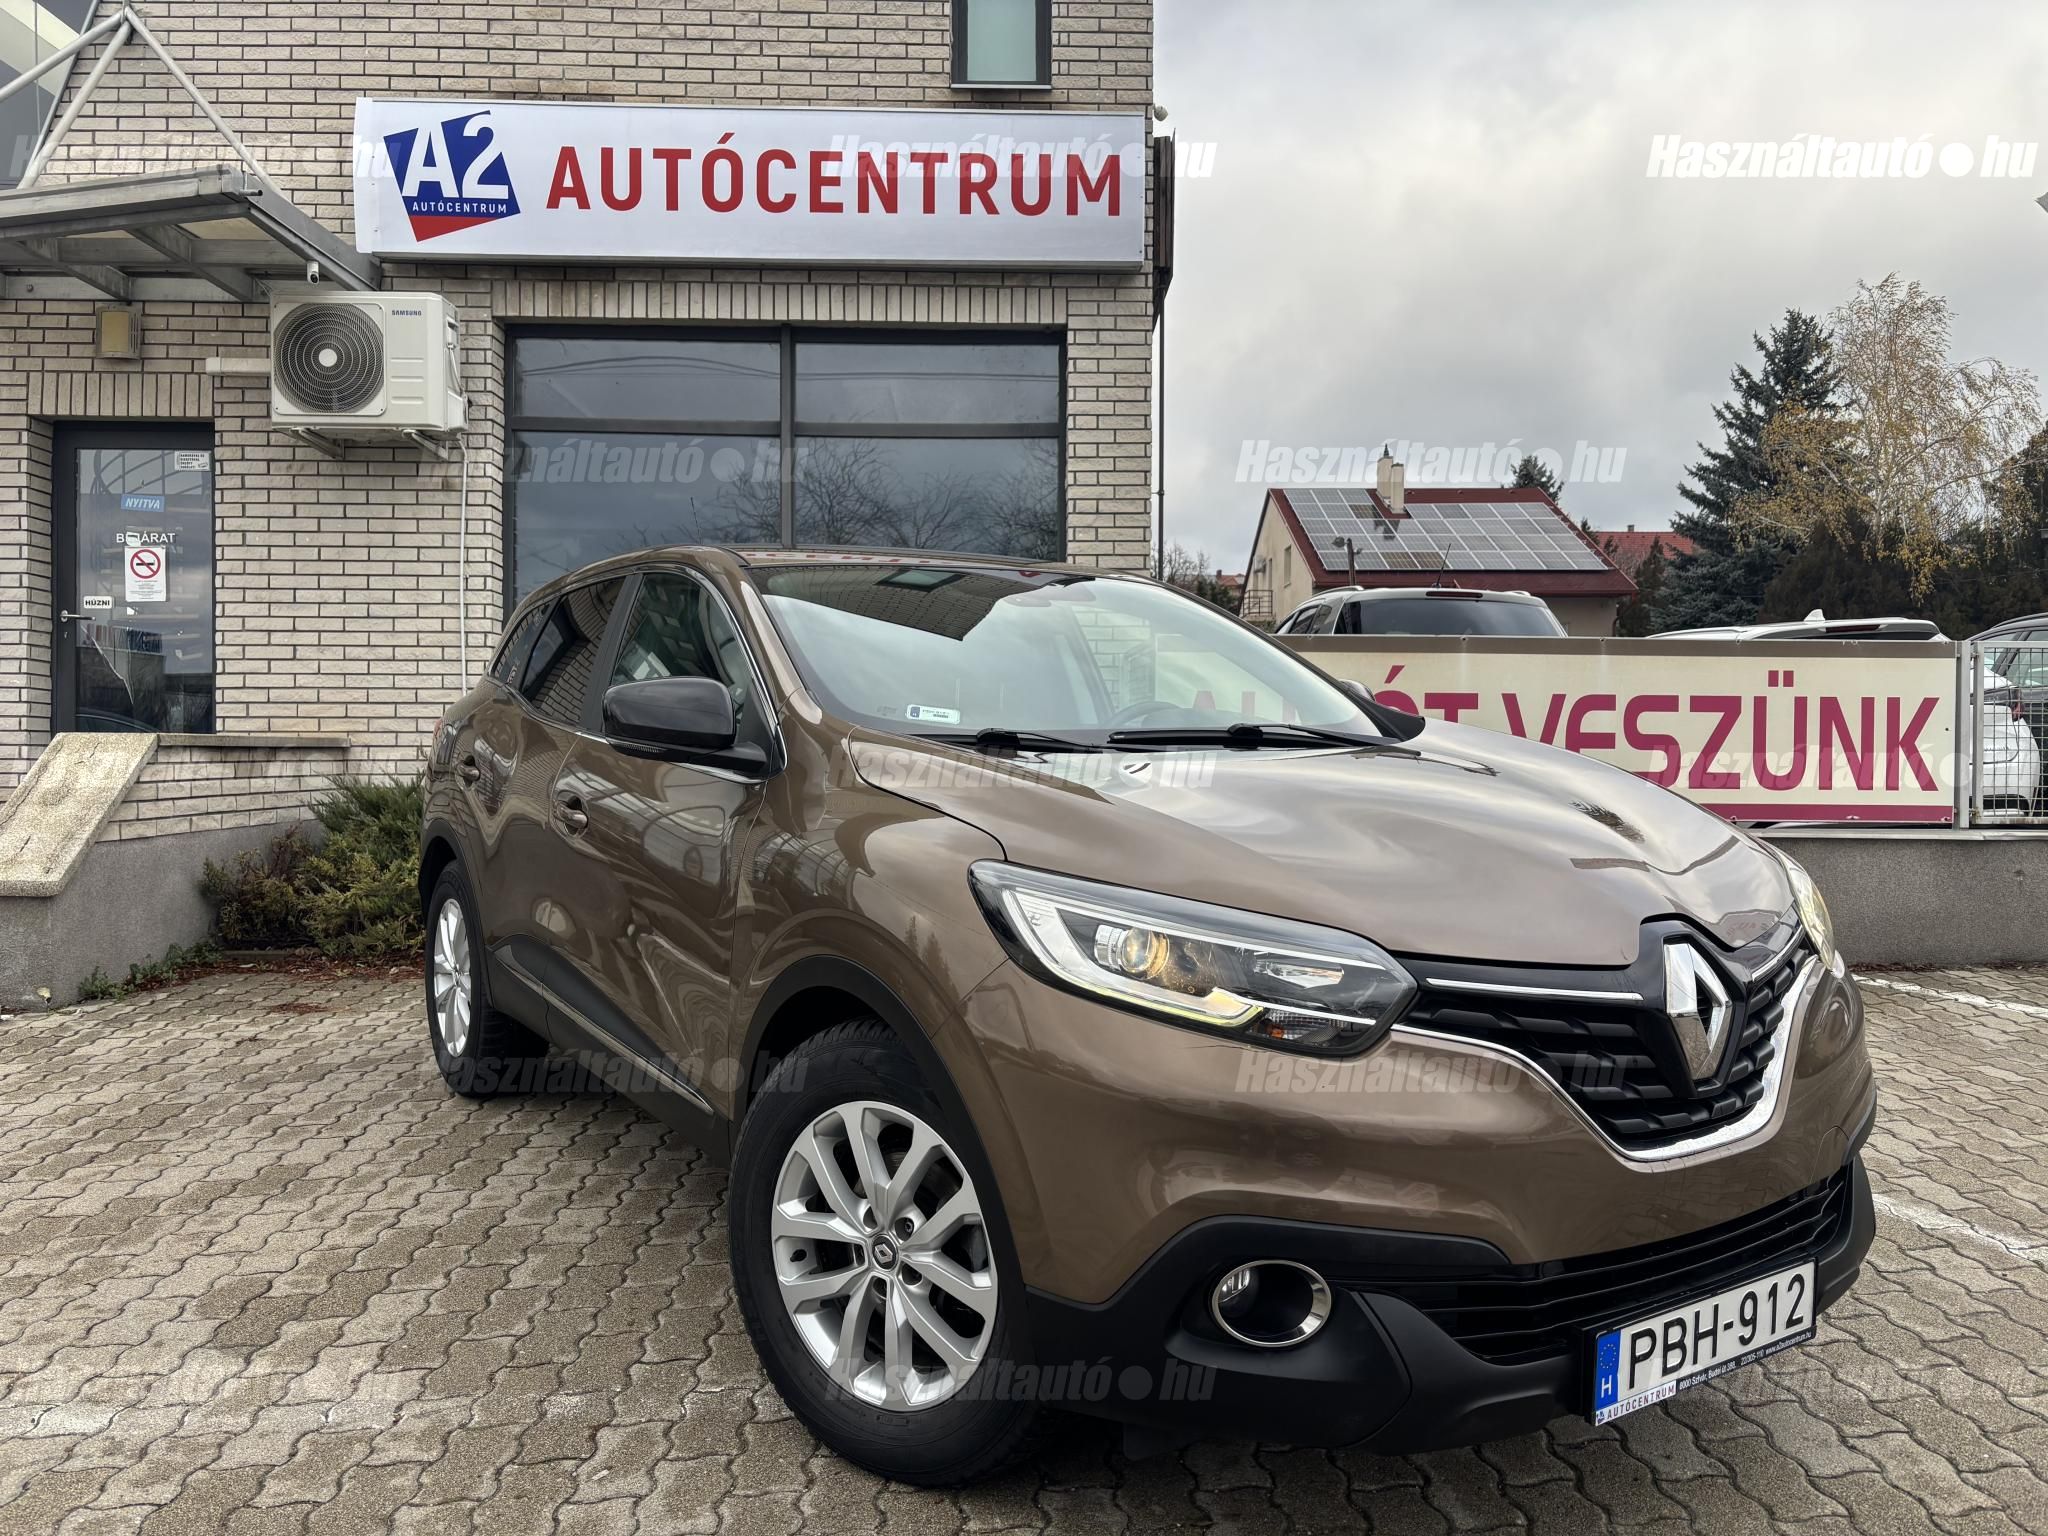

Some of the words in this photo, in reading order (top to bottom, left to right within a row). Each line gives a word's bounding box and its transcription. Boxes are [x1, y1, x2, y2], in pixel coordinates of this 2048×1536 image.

[402, 113, 509, 200] A2
[546, 132, 1121, 217] AUTÓCENTRUM
[411, 200, 508, 214] AUTÓCENTRUM
[125, 497, 161, 510] NYITVA
[116, 530, 176, 543] BÁRAT
[85, 598, 110, 606] HÚZNI
[1501, 670, 1940, 791] VESZÜNK
[1628, 1273, 1806, 1390] PBH-912
[1600, 1375, 1612, 1400] H
[1607, 1384, 1676, 1420] AUTÓCENTRUM
